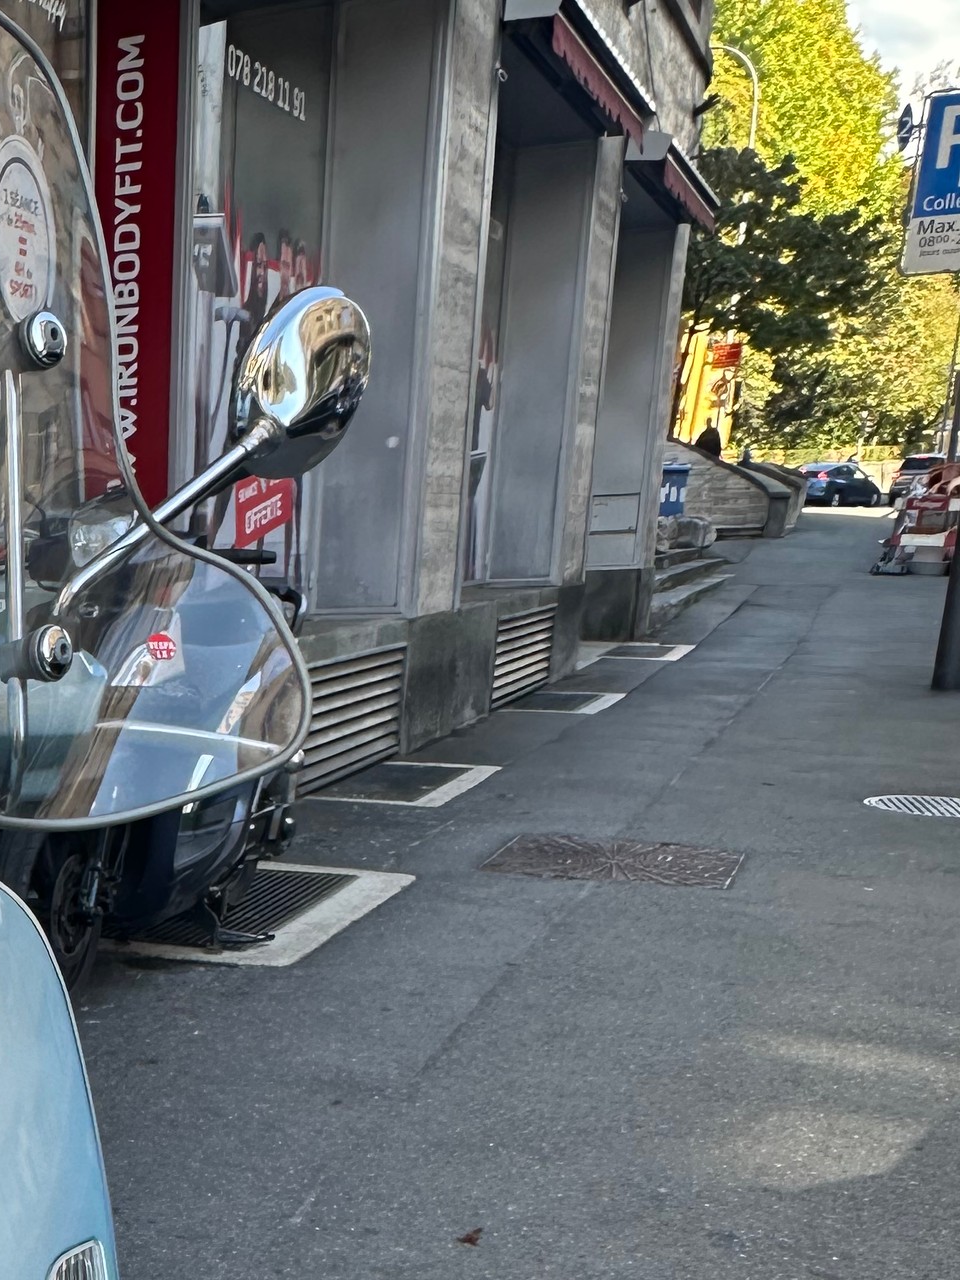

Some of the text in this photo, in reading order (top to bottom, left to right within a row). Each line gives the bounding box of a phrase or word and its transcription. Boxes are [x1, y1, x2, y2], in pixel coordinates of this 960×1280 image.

[227, 44, 251, 86] 078
[253, 61, 275, 102] 218
[277, 77, 290, 112] 11
[293, 87, 305, 121] 91
